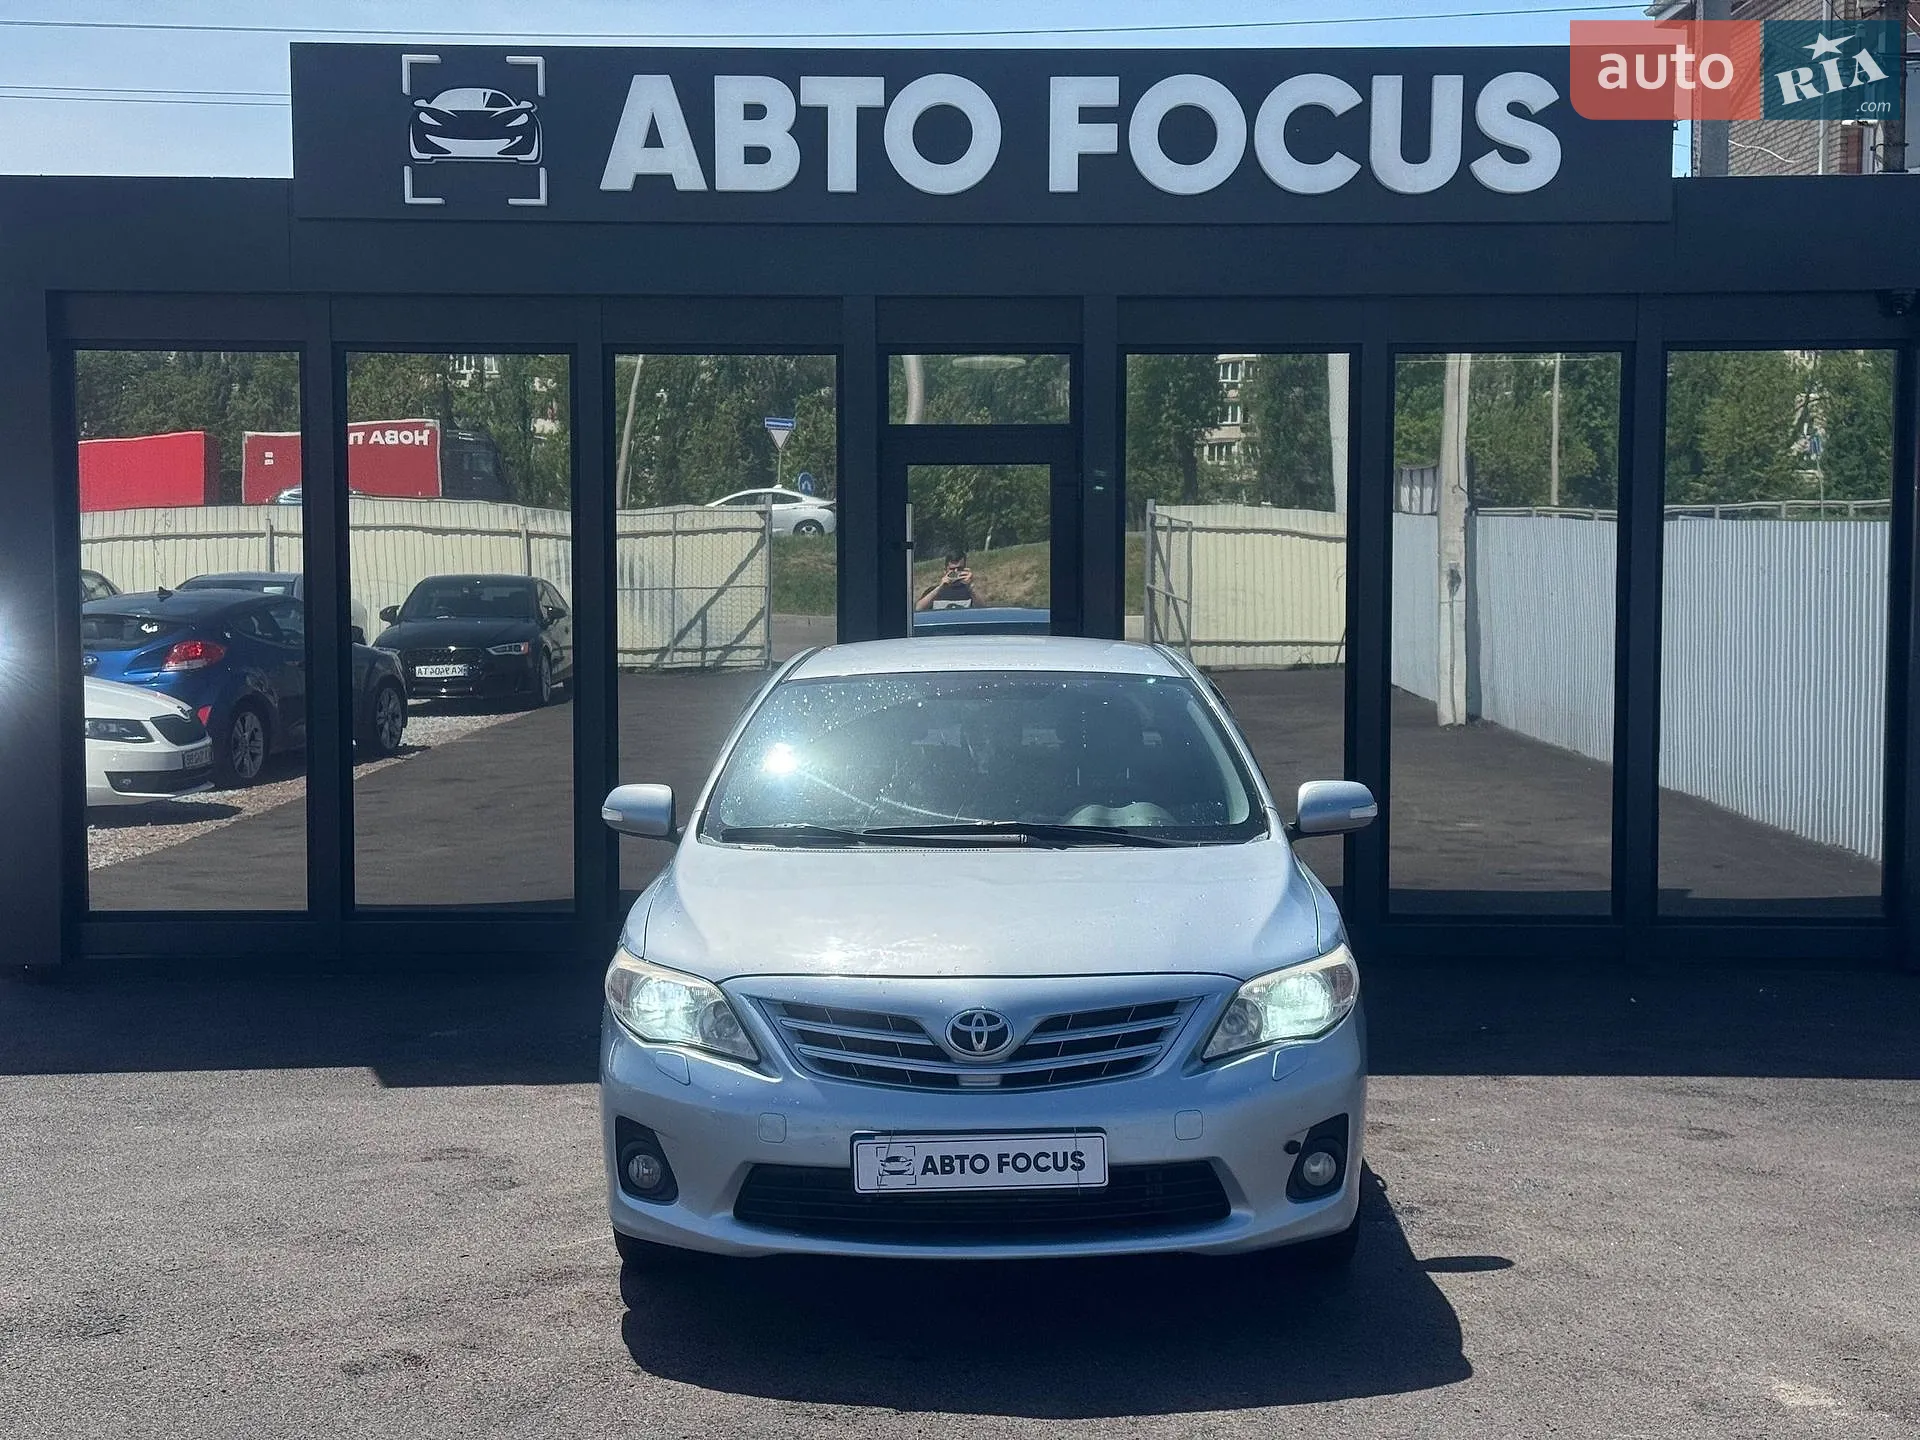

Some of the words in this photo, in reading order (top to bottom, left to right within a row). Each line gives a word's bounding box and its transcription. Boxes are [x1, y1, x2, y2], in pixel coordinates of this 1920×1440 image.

[599, 73, 1002, 194] АВТО
[1048, 72, 1562, 195] FOCUS
[921, 1154, 990, 1175] АВТО
[997, 1151, 1086, 1173] FOCUS
